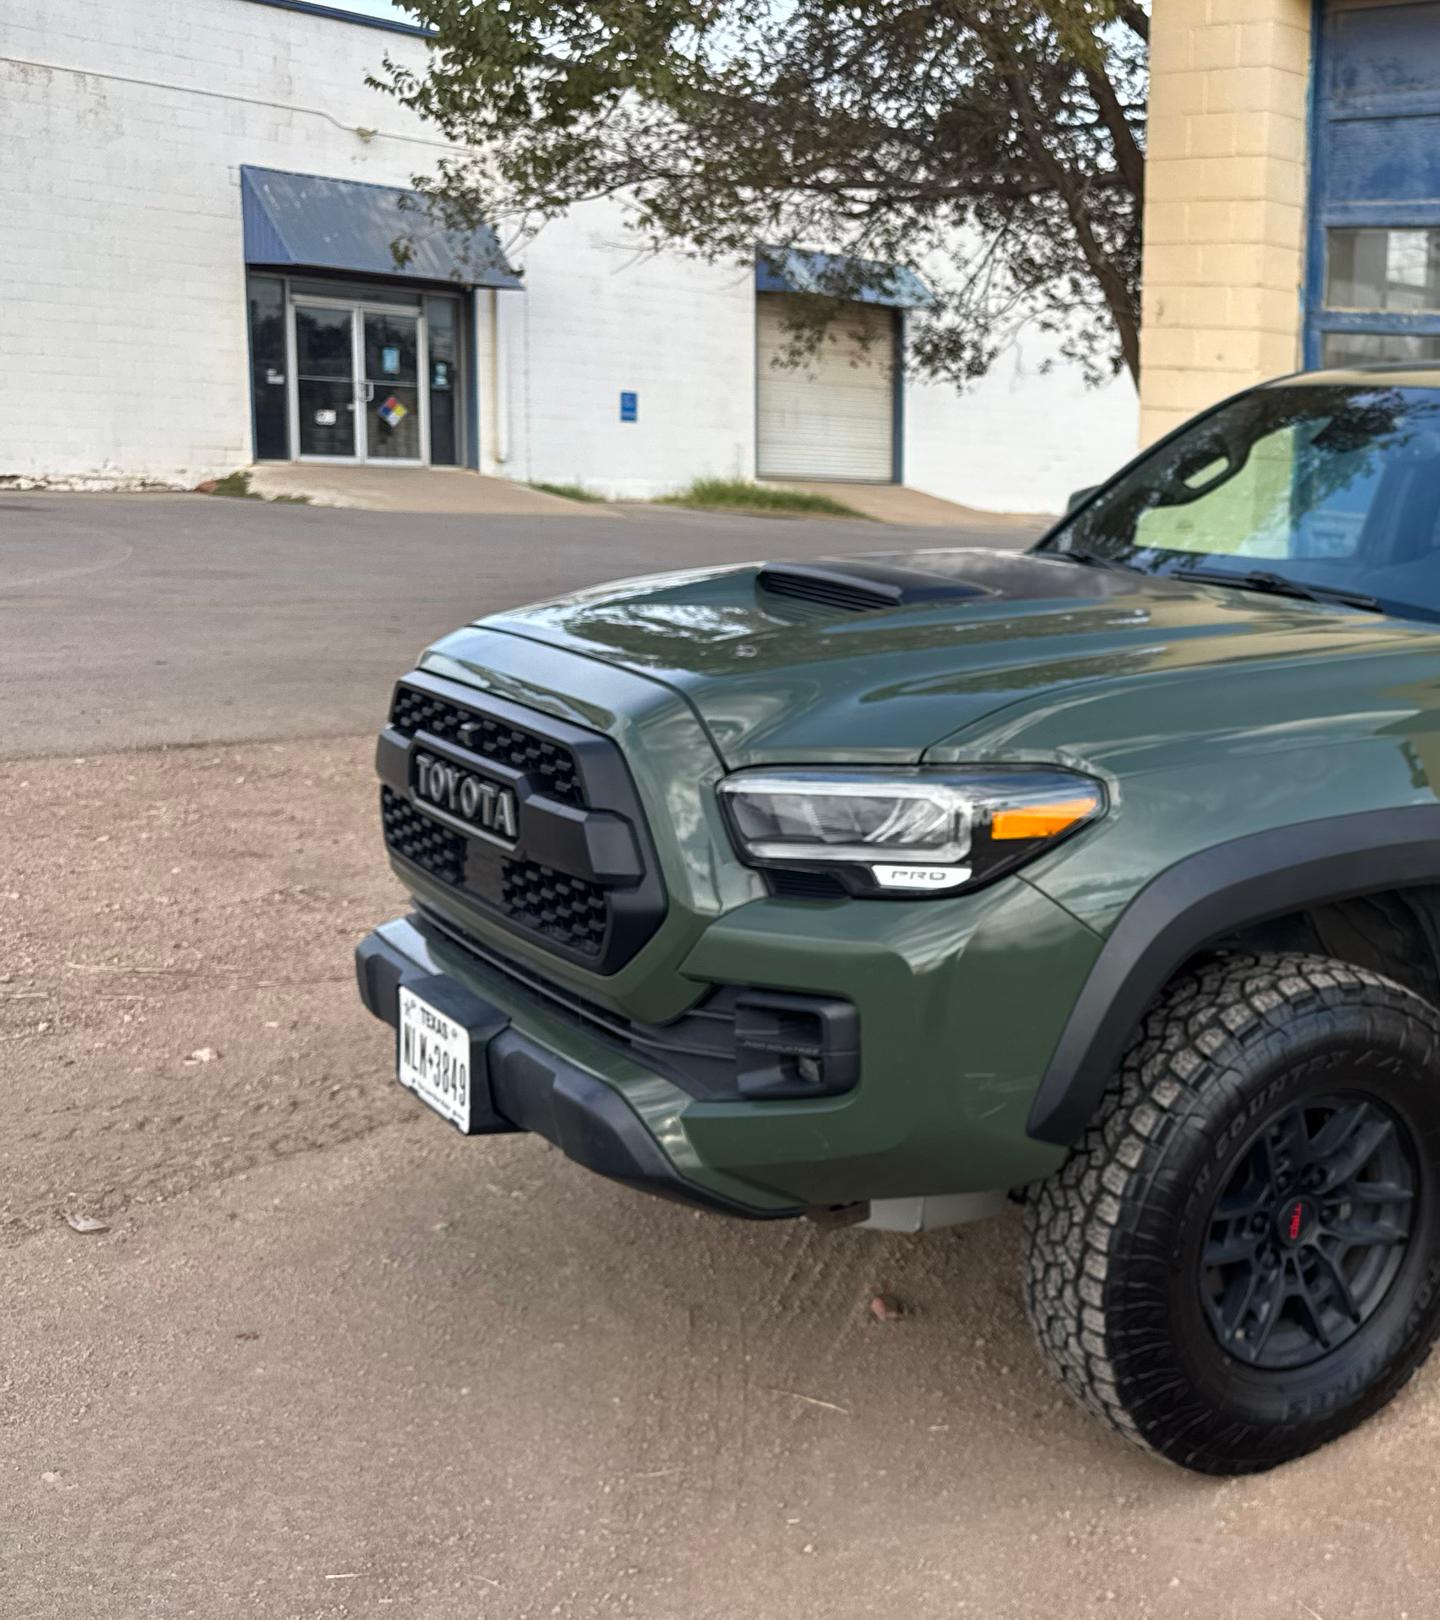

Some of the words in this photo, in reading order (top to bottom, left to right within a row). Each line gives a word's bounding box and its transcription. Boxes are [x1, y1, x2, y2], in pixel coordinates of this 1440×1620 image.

[416, 752, 518, 837] TOYOTA
[891, 870, 946, 881] PRO
[420, 1007, 448, 1039] TEXAS
